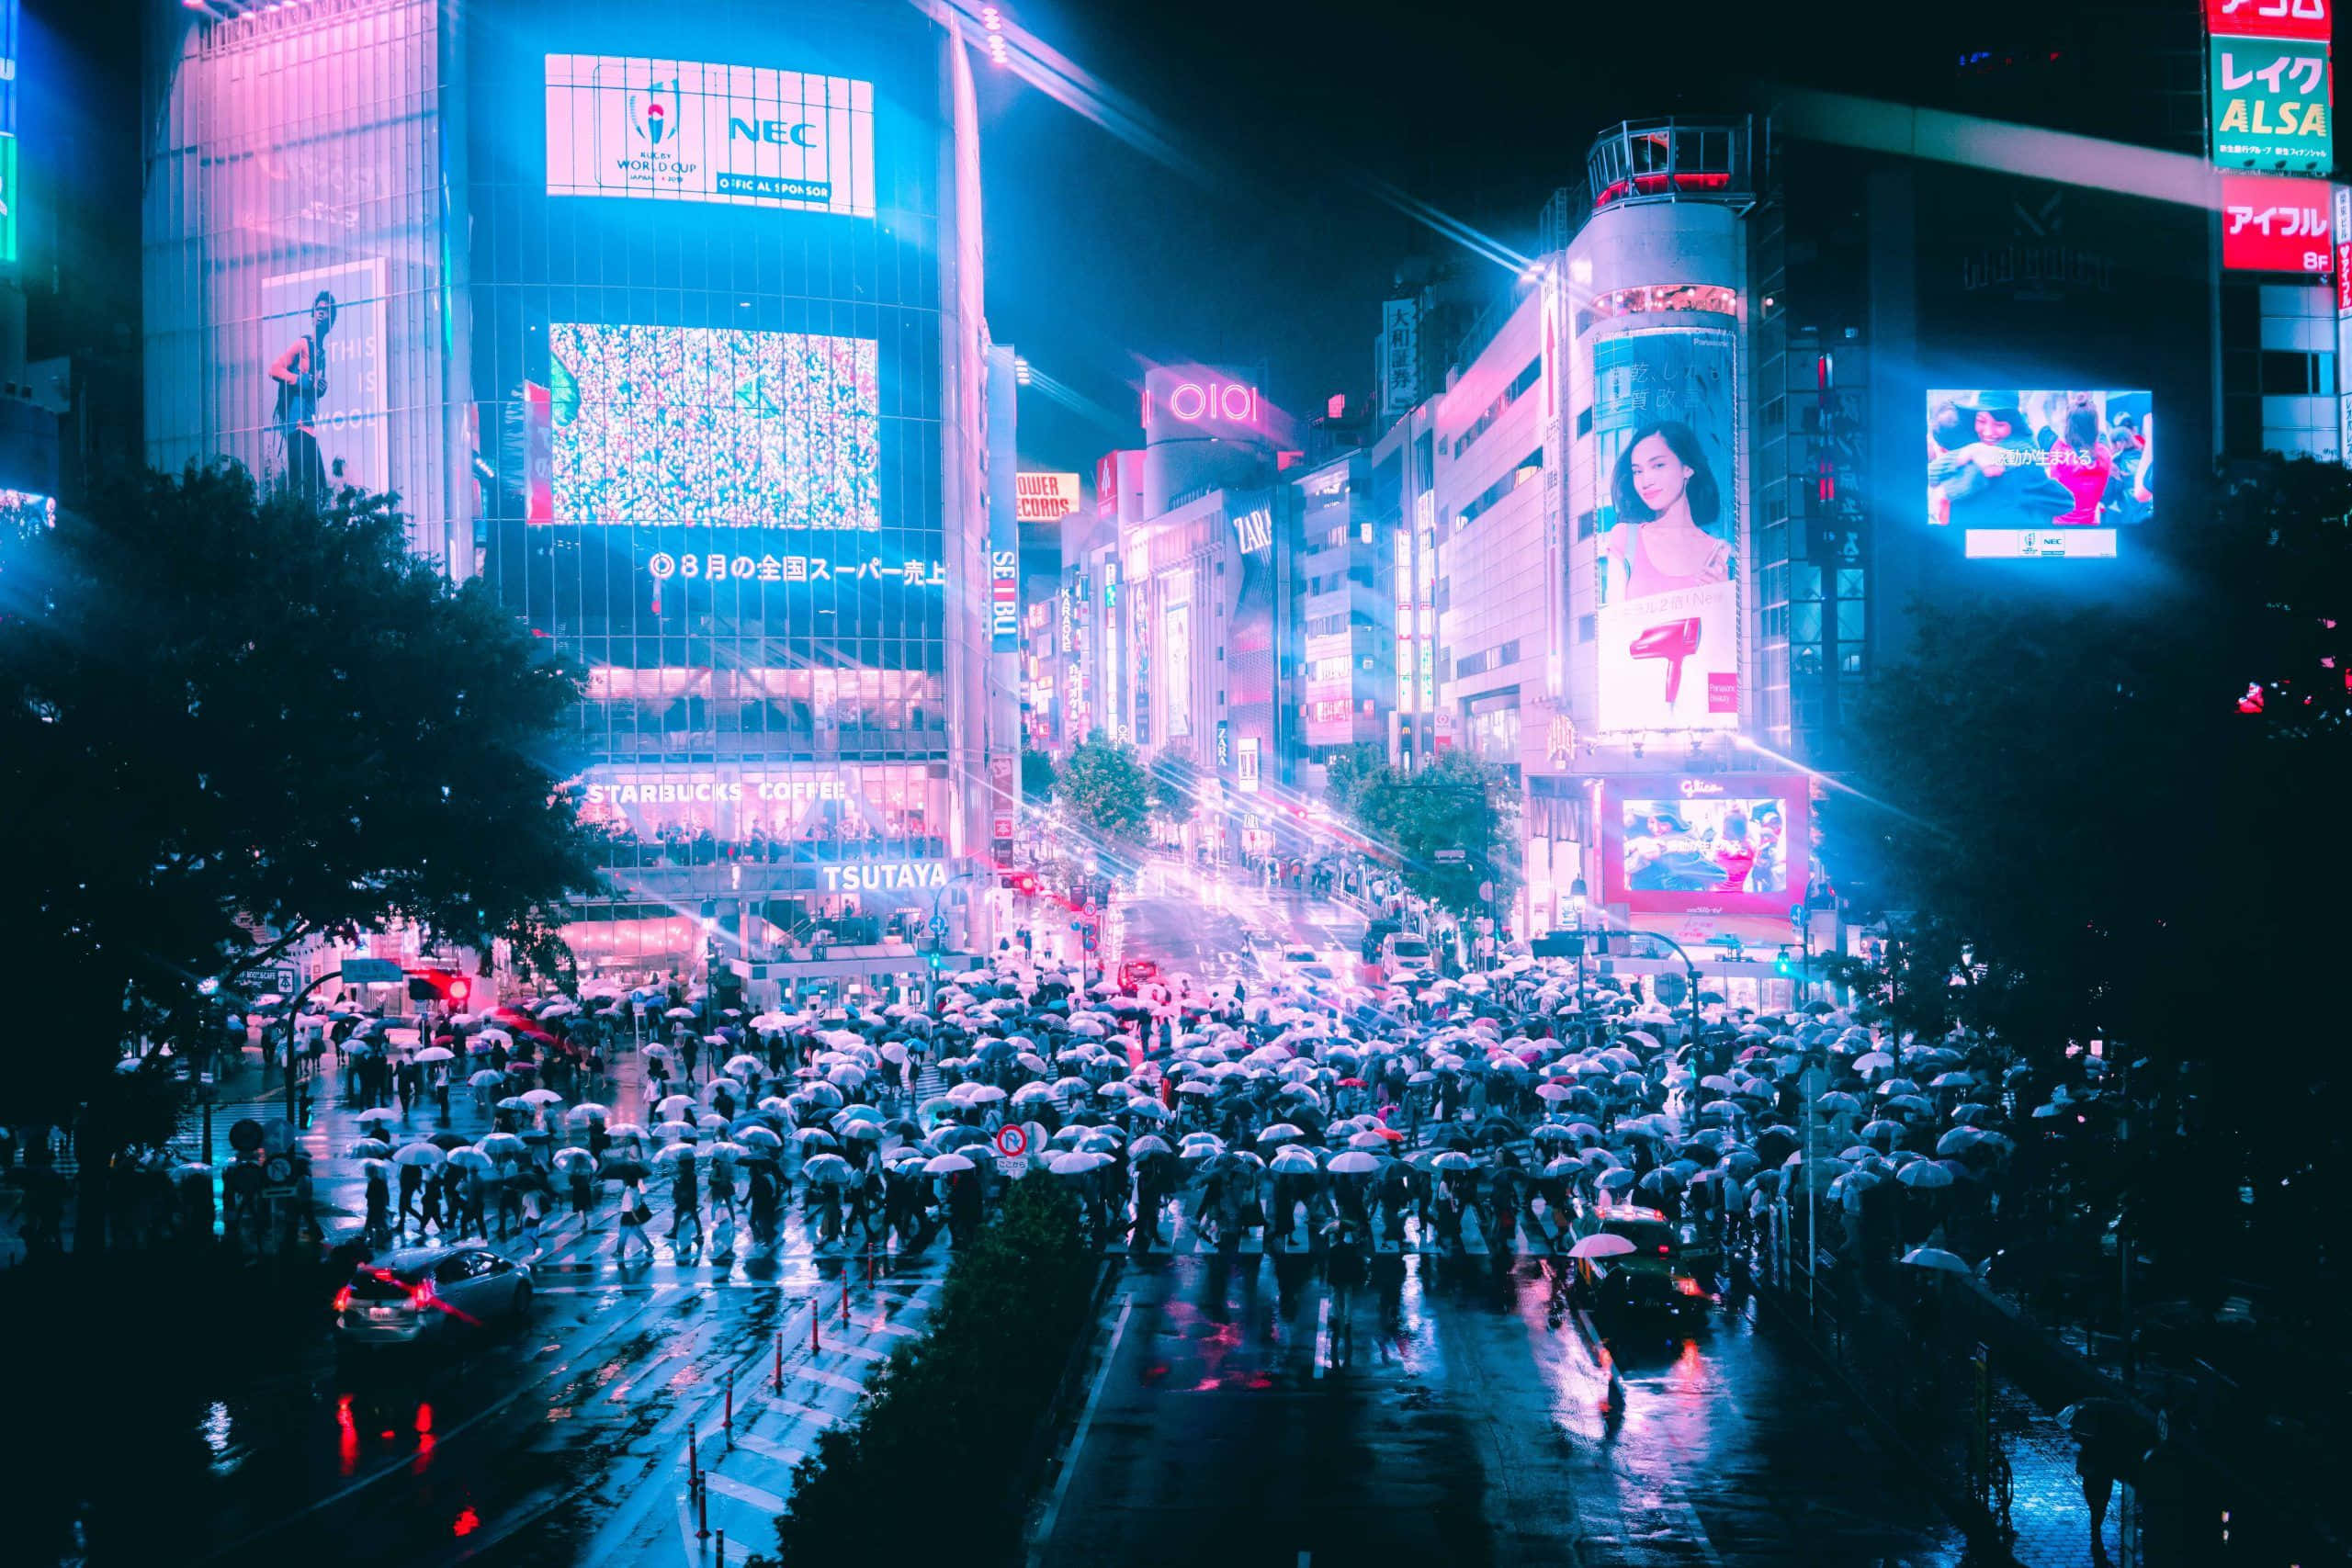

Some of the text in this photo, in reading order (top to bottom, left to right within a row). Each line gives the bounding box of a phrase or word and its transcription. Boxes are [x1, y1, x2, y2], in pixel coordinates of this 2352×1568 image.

[2222, 52, 2323, 94] レイク
[2220, 98, 2327, 137] ALSA
[730, 118, 817, 148] NEC
[616, 160, 697, 174] WORLD CUP
[719, 178, 772, 192] OFICAL
[2226, 206, 2328, 237] アイフル
[2303, 252, 2328, 269] 8F
[328, 336, 376, 363] THIS
[358, 370, 376, 394] IS
[311, 407, 376, 433] WOOL
[1016, 475, 1059, 496] OWER
[1016, 497, 1069, 517] ECORDS
[993, 551, 1017, 635] SEIBU
[1061, 588, 1072, 652] KARAOKE
[1217, 728, 1227, 766] ZARA
[588, 782, 846, 804] STARBUCKS COFFEE
[823, 863, 947, 891] TSUTAYA
[999, 1160, 1026, 1168] ここから
